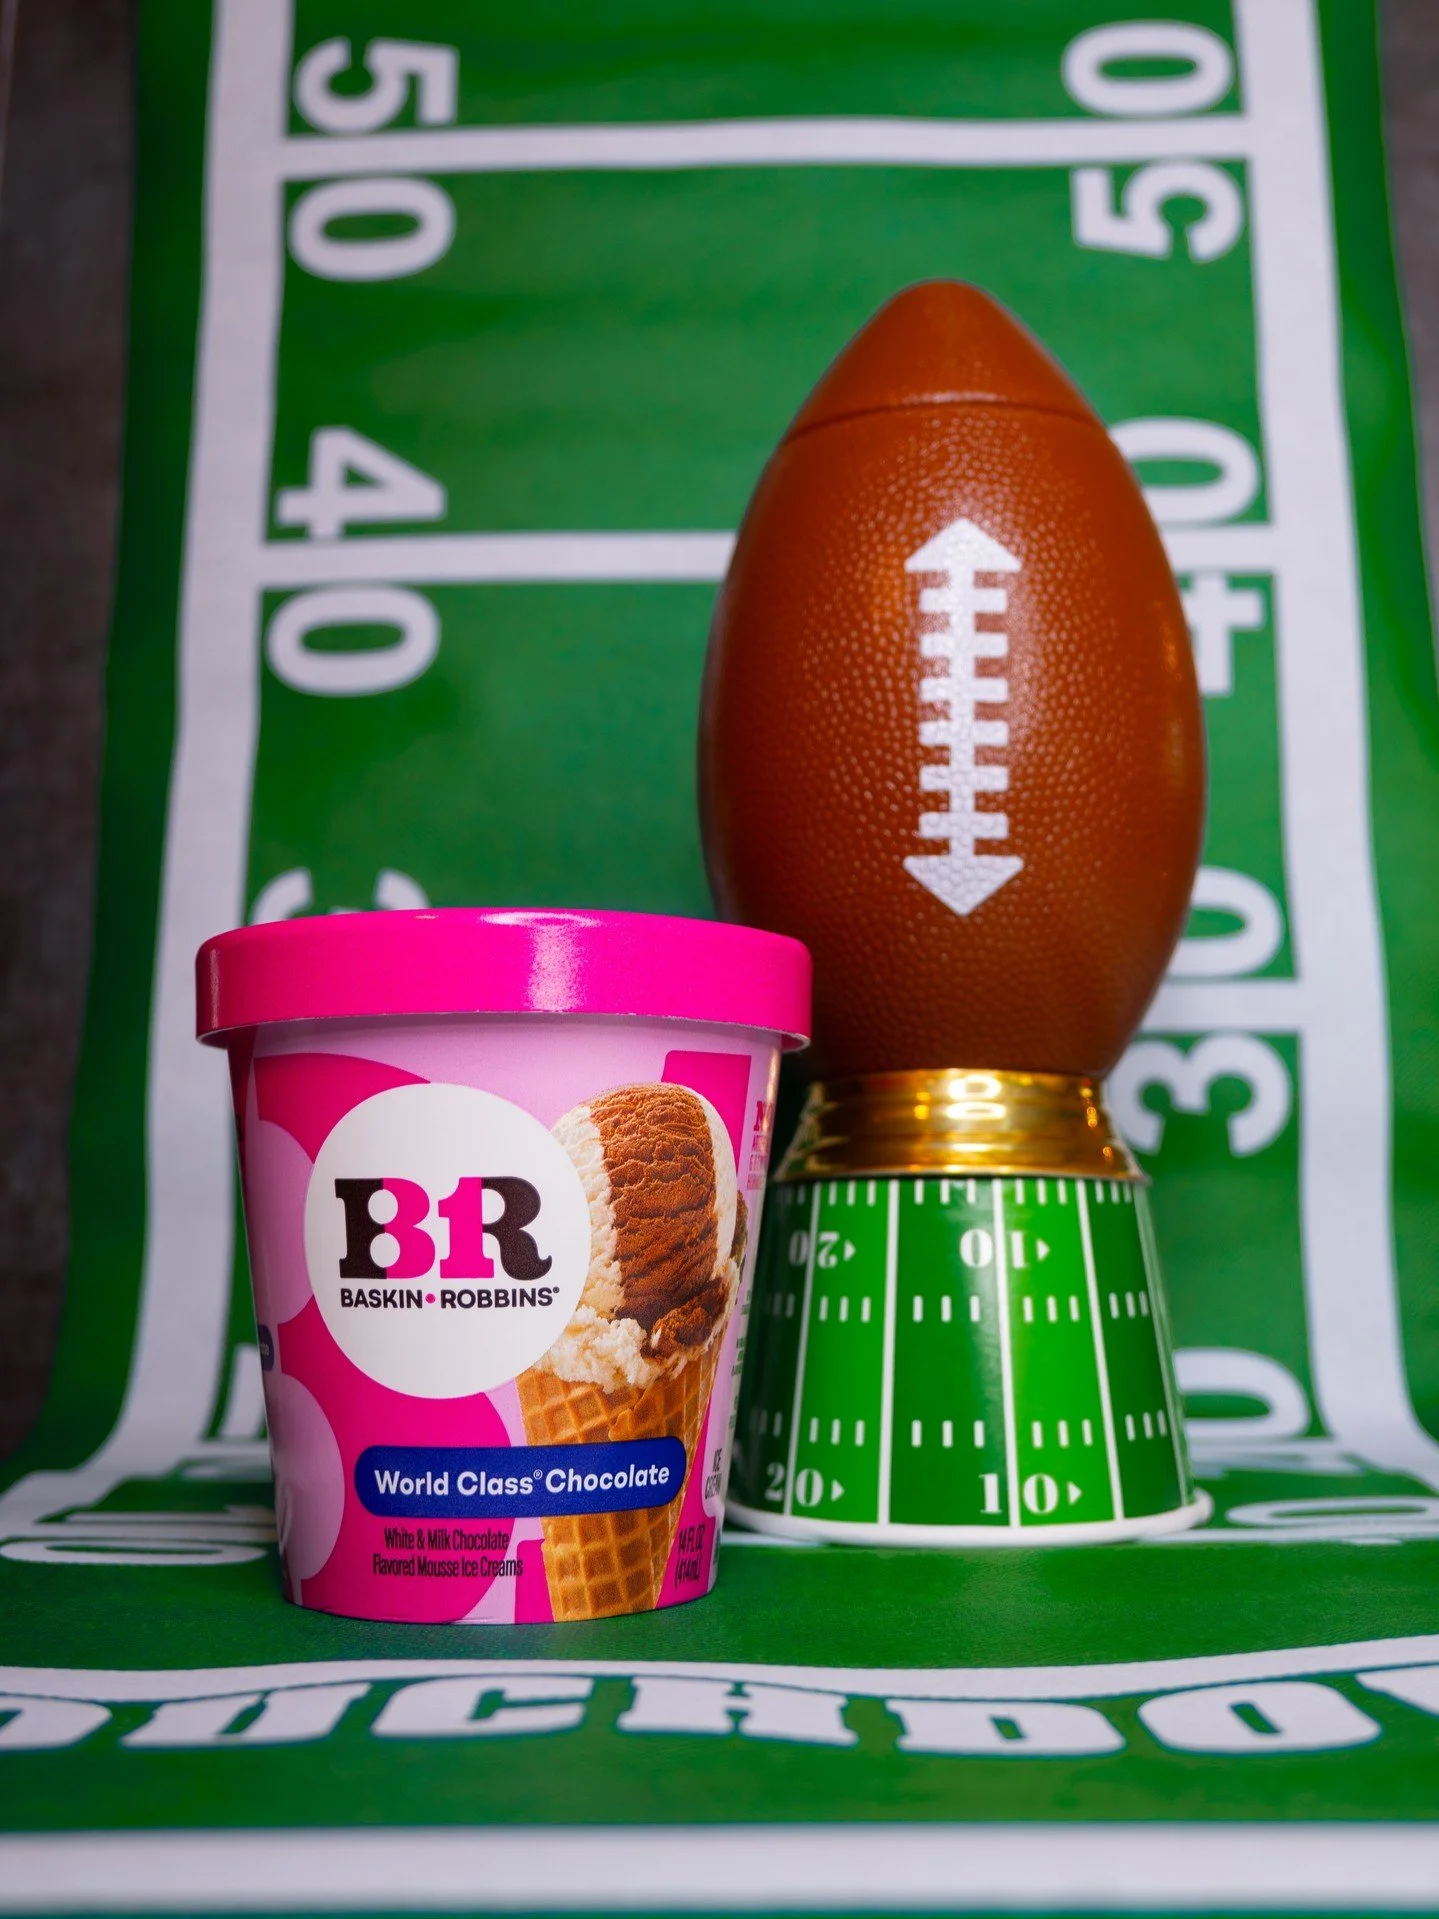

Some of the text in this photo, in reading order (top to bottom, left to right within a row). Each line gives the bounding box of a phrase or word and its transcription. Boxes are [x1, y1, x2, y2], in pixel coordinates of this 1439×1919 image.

[288, 37, 458, 281] 50
[1062, 19, 1244, 262] 50
[265, 425, 448, 697] 40
[341, 1288, 422, 1308] BASKIN
[374, 1470, 449, 1495] World
[545, 1464, 670, 1493] Chocolate
[764, 1462, 824, 1507] 20
[978, 1472, 1059, 1514] 10
[384, 1527, 509, 1550] White & Milk Chocolate
[372, 1553, 523, 1577] Flavored Mousse Ice Creams
